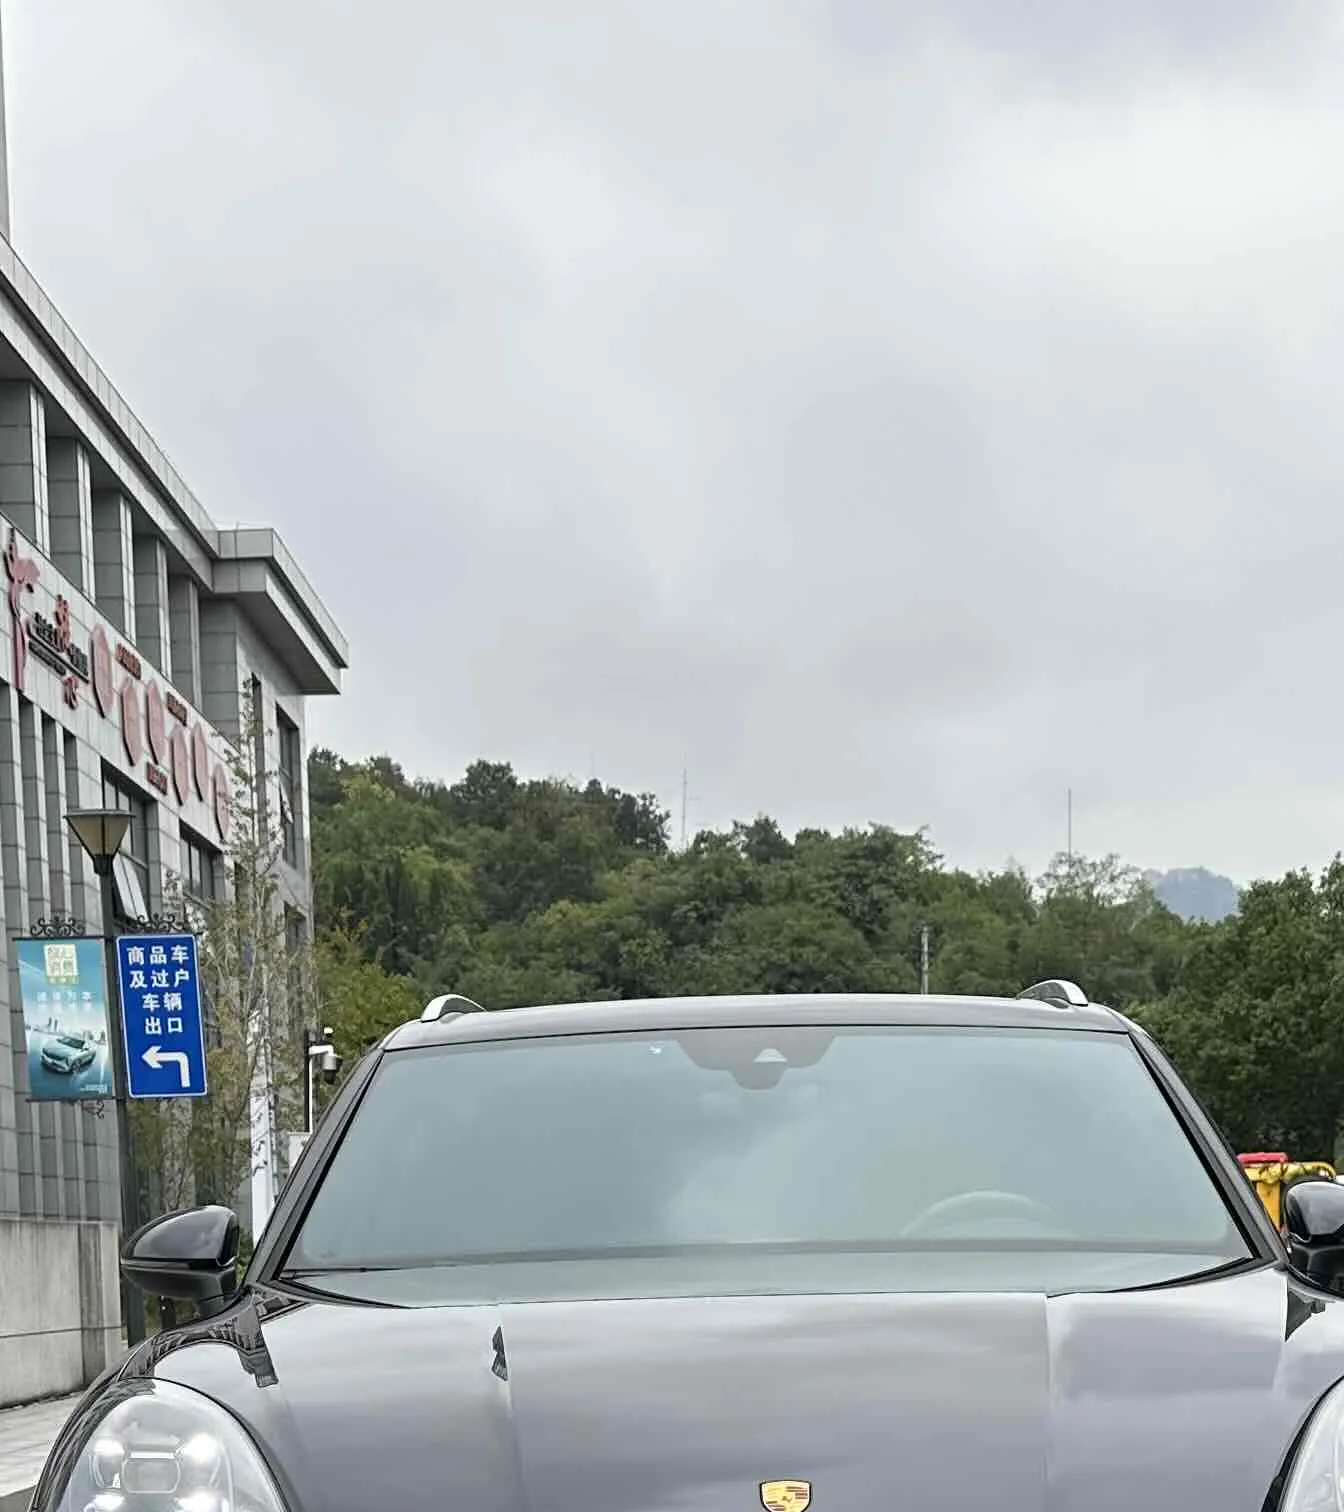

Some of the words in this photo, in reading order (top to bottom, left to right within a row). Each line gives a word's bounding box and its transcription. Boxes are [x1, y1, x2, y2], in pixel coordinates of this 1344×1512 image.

[126, 945, 190, 966] 商品车
[128, 969, 190, 990] 及过户
[142, 992, 184, 1012] 车辆
[144, 1016, 184, 1036] 出口
